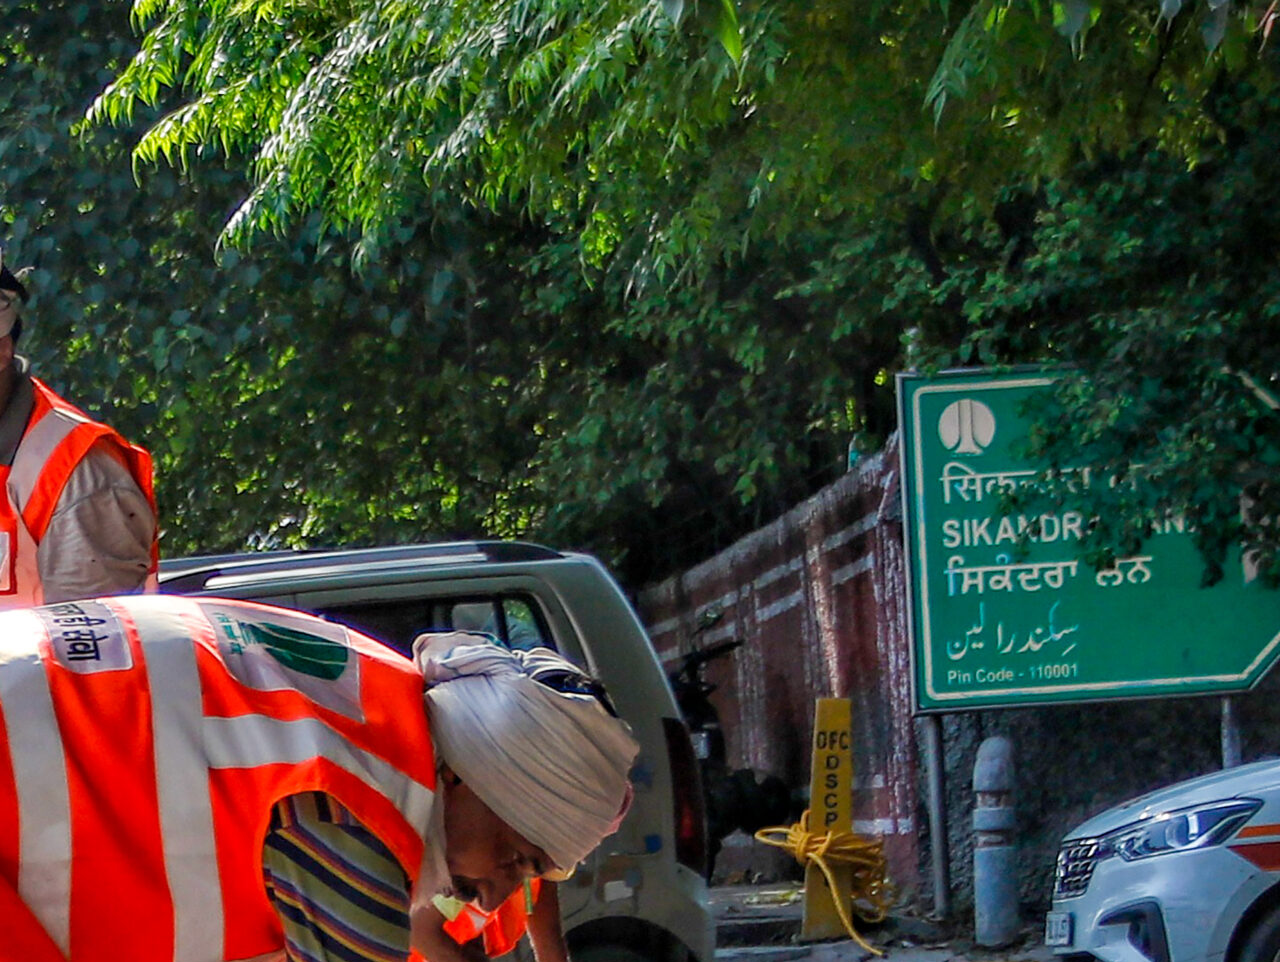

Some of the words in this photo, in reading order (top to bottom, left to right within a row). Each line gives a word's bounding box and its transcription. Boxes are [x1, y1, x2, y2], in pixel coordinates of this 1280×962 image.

[943, 511, 1100, 549] SIKANDR
[62, 629, 109, 661] सेवा
[947, 669, 971, 685] Pin
[975, 667, 1014, 684] Code
[1029, 663, 1078, 681] 110001
[816, 731, 849, 750] OFC
